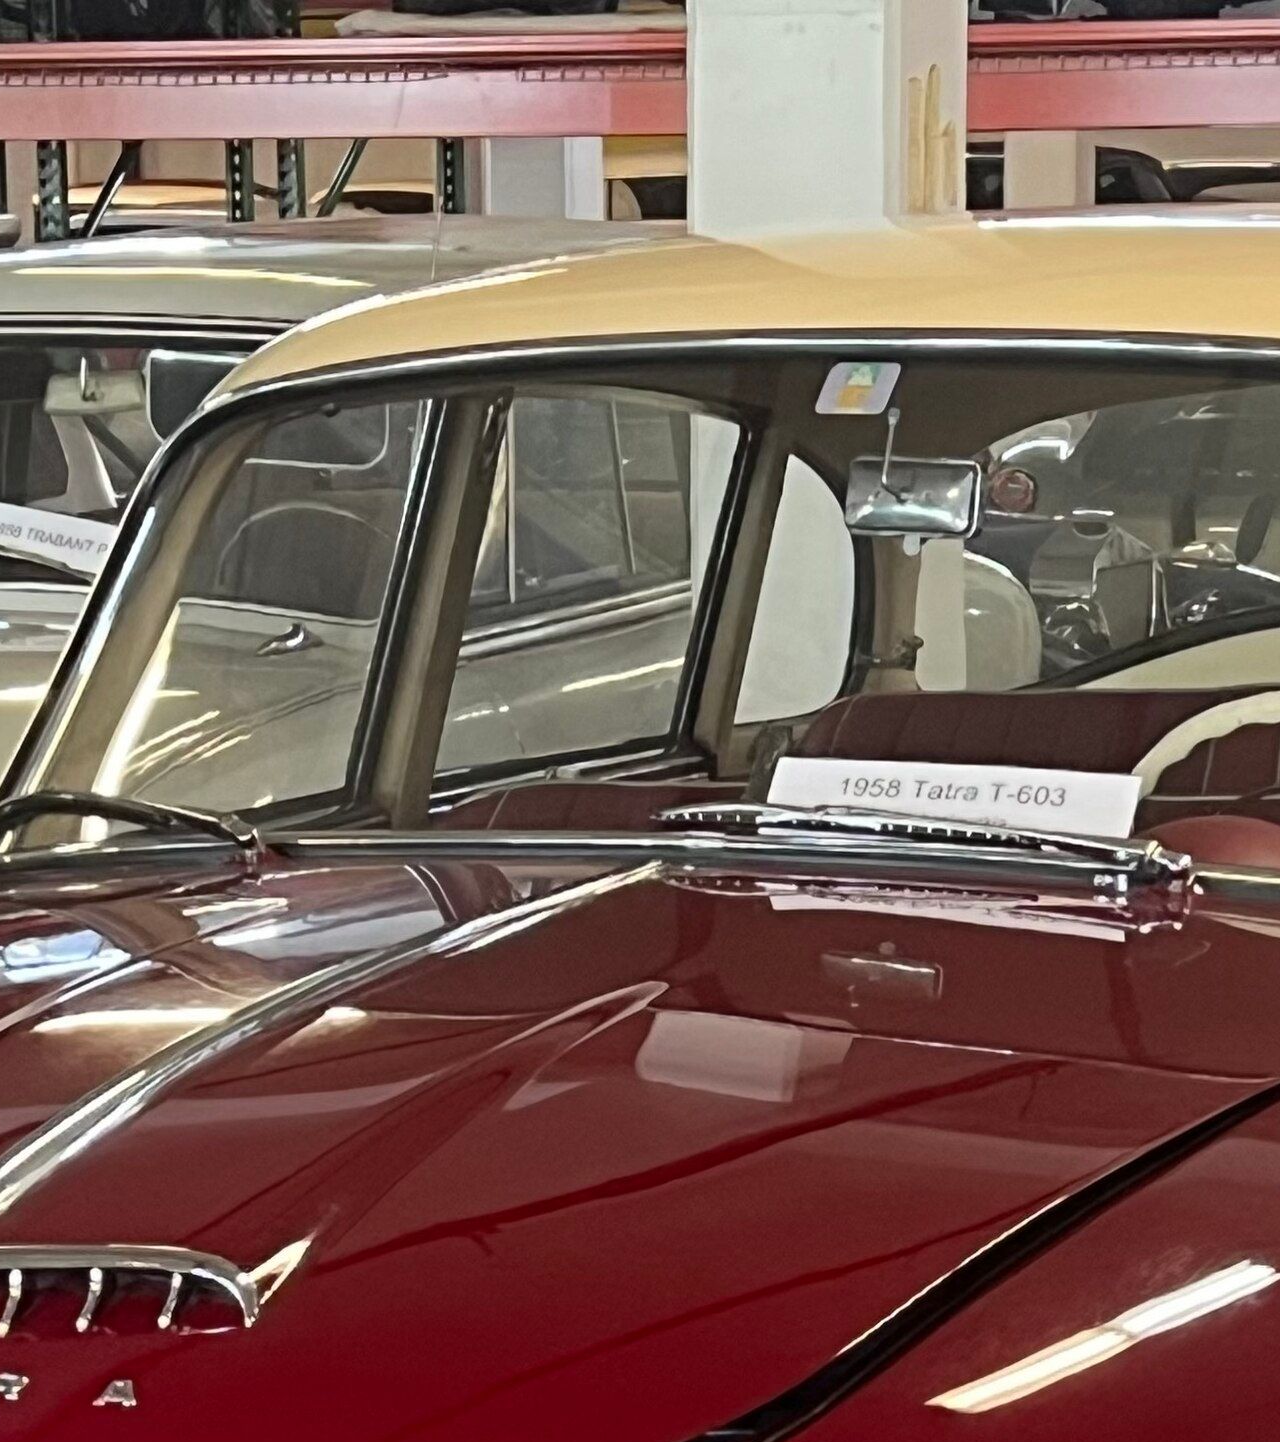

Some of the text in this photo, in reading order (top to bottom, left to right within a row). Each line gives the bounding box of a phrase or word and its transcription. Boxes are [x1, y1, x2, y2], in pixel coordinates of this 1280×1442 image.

[26, 527, 94, 551] TRABANT
[841, 777, 1067, 807] 1958 Tatra T-603
